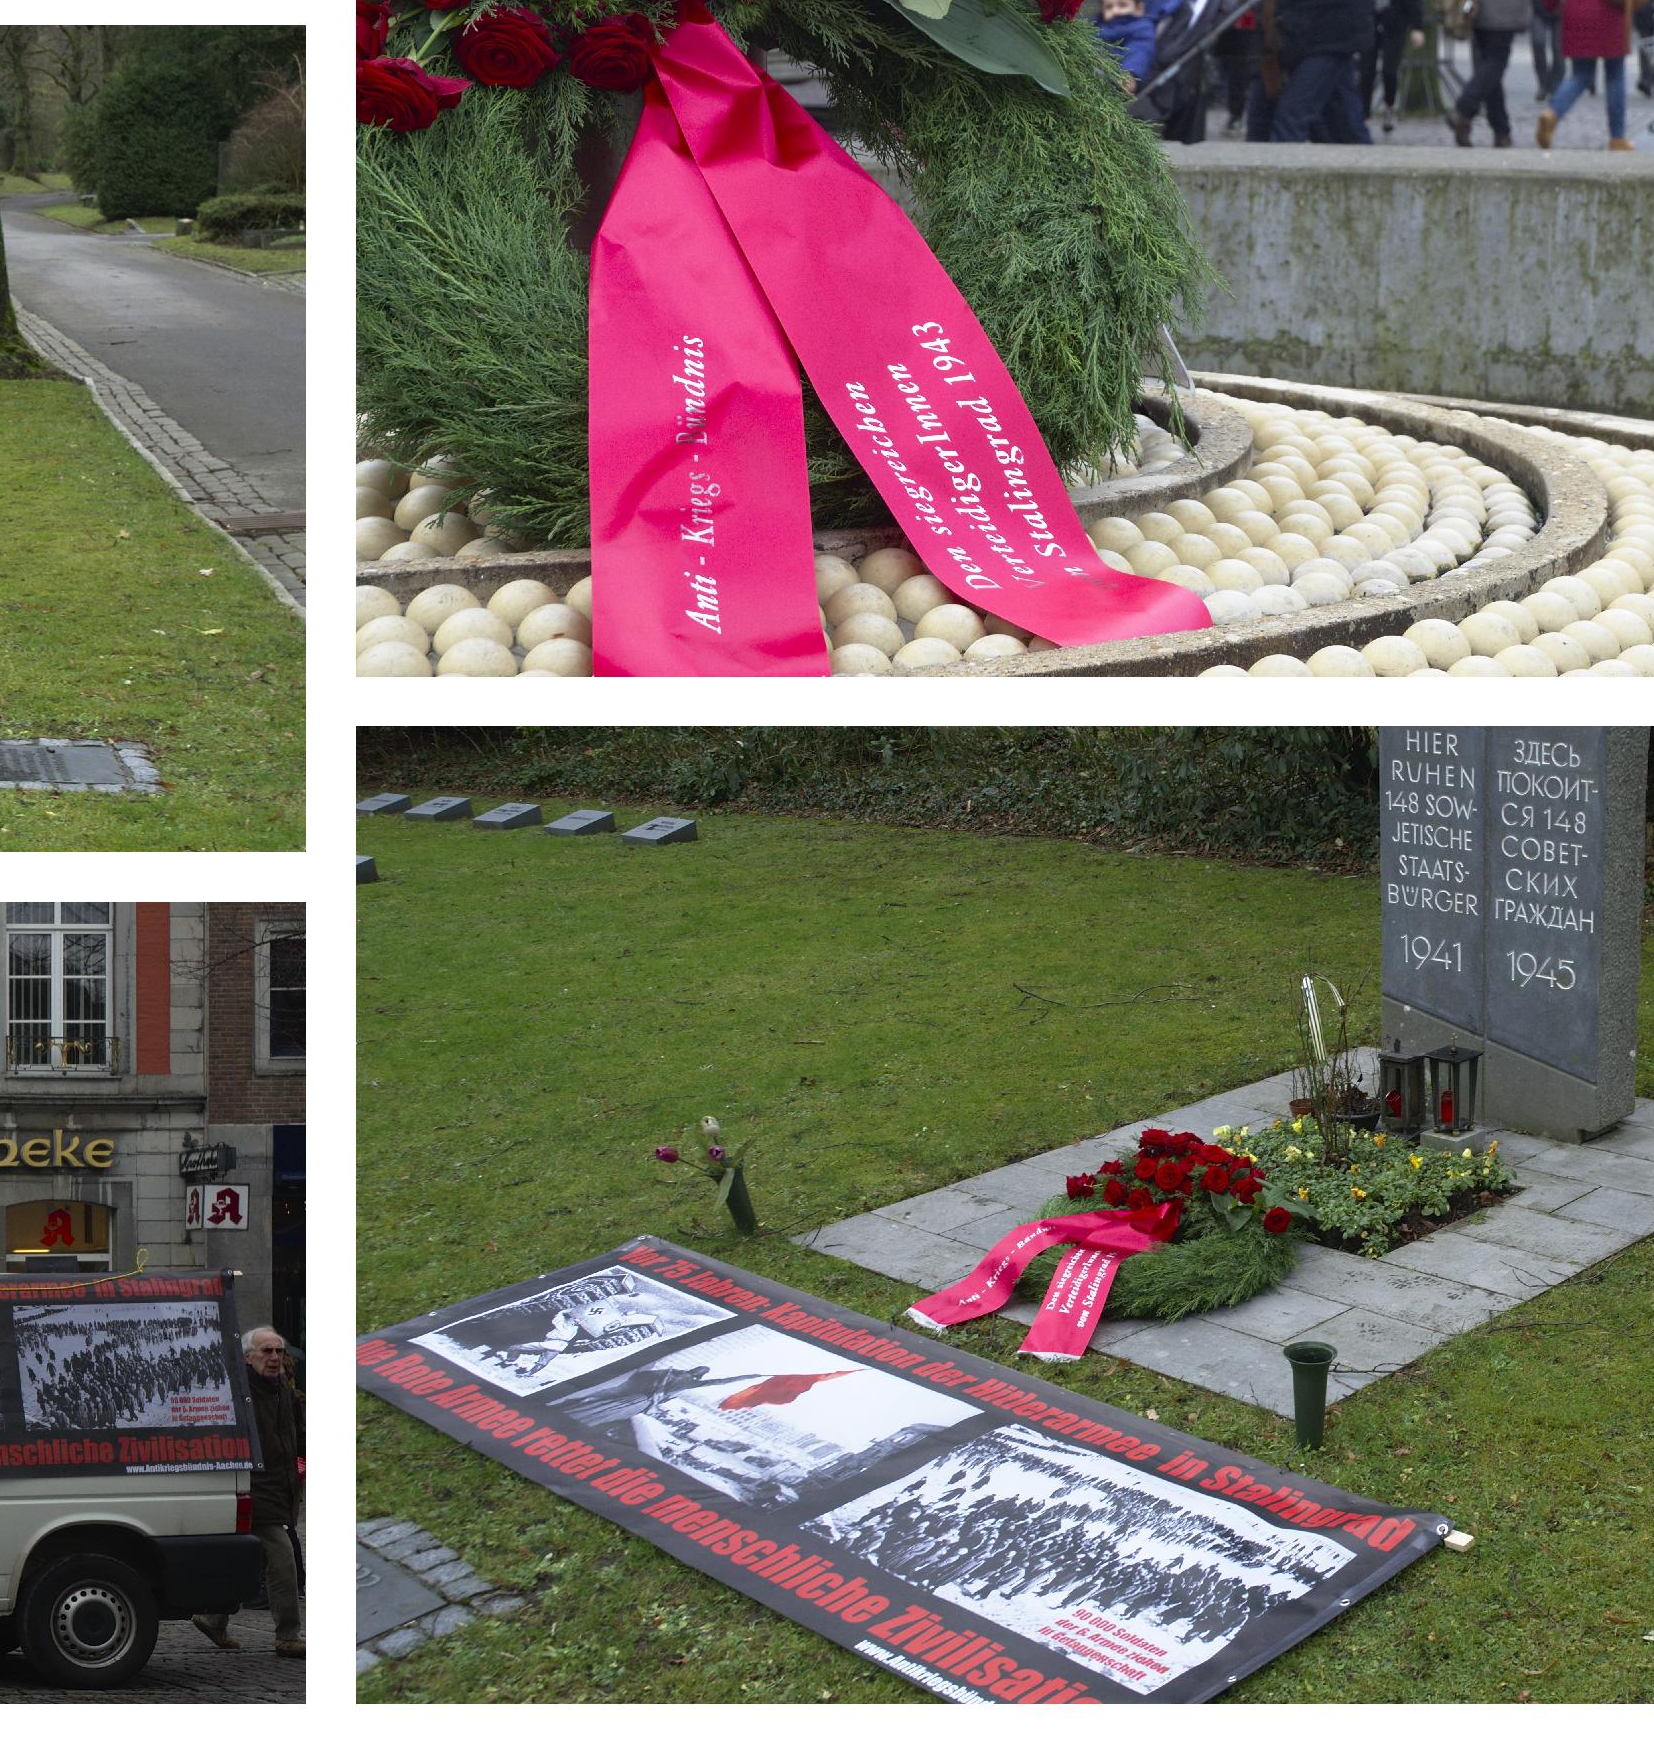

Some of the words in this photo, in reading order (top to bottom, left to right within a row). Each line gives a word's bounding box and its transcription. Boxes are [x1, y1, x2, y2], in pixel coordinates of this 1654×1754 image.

[911, 320, 976, 386] 1943
[673, 334, 709, 447] Bündnis
[844, 381, 954, 537] siegreichen
[955, 395, 1068, 561] Stalingrad
[680, 469, 722, 547] Kriegs
[946, 545, 1004, 592] Den
[684, 568, 723, 635] Anti
[1406, 729, 1459, 757] HIER
[1513, 739, 1582, 768] ЗДЕСЬ
[1391, 759, 1476, 792] RUHEN
[1497, 770, 1599, 803] ПОКОИТ-
[1385, 789, 1420, 814] 148
[1425, 793, 1478, 821] SOW-
[1500, 802, 1536, 828] СЯ
[1543, 808, 1587, 835] 148
[1391, 821, 1474, 852] JETISCHE
[1500, 835, 1589, 866] СОВЕТ-
[1398, 854, 1471, 883] STAATS-
[1505, 868, 1579, 900] СКИХ
[1387, 883, 1479, 917] BÜRGER
[1495, 898, 1595, 934] ГРАЖДАН
[1400, 934, 1463, 973] 1941
[1506, 950, 1577, 991] 1945
[119, 1275, 224, 1298] Stalingrad
[679, 1265, 769, 1315] Jahren:
[764, 1300, 933, 1380] Kapitulation
[964, 1375, 1161, 1461] Hitlerarmee
[1156, 1449, 1209, 1483] in
[1200, 1465, 1418, 1553] Stalingrad
[118, 1434, 252, 1464] Zivilisation
[387, 1350, 455, 1402] Rote
[444, 1380, 537, 1441] Armee
[510, 1424, 622, 1481] rettet
[592, 1461, 666, 1507] die
[643, 1492, 893, 1625] menschliche
